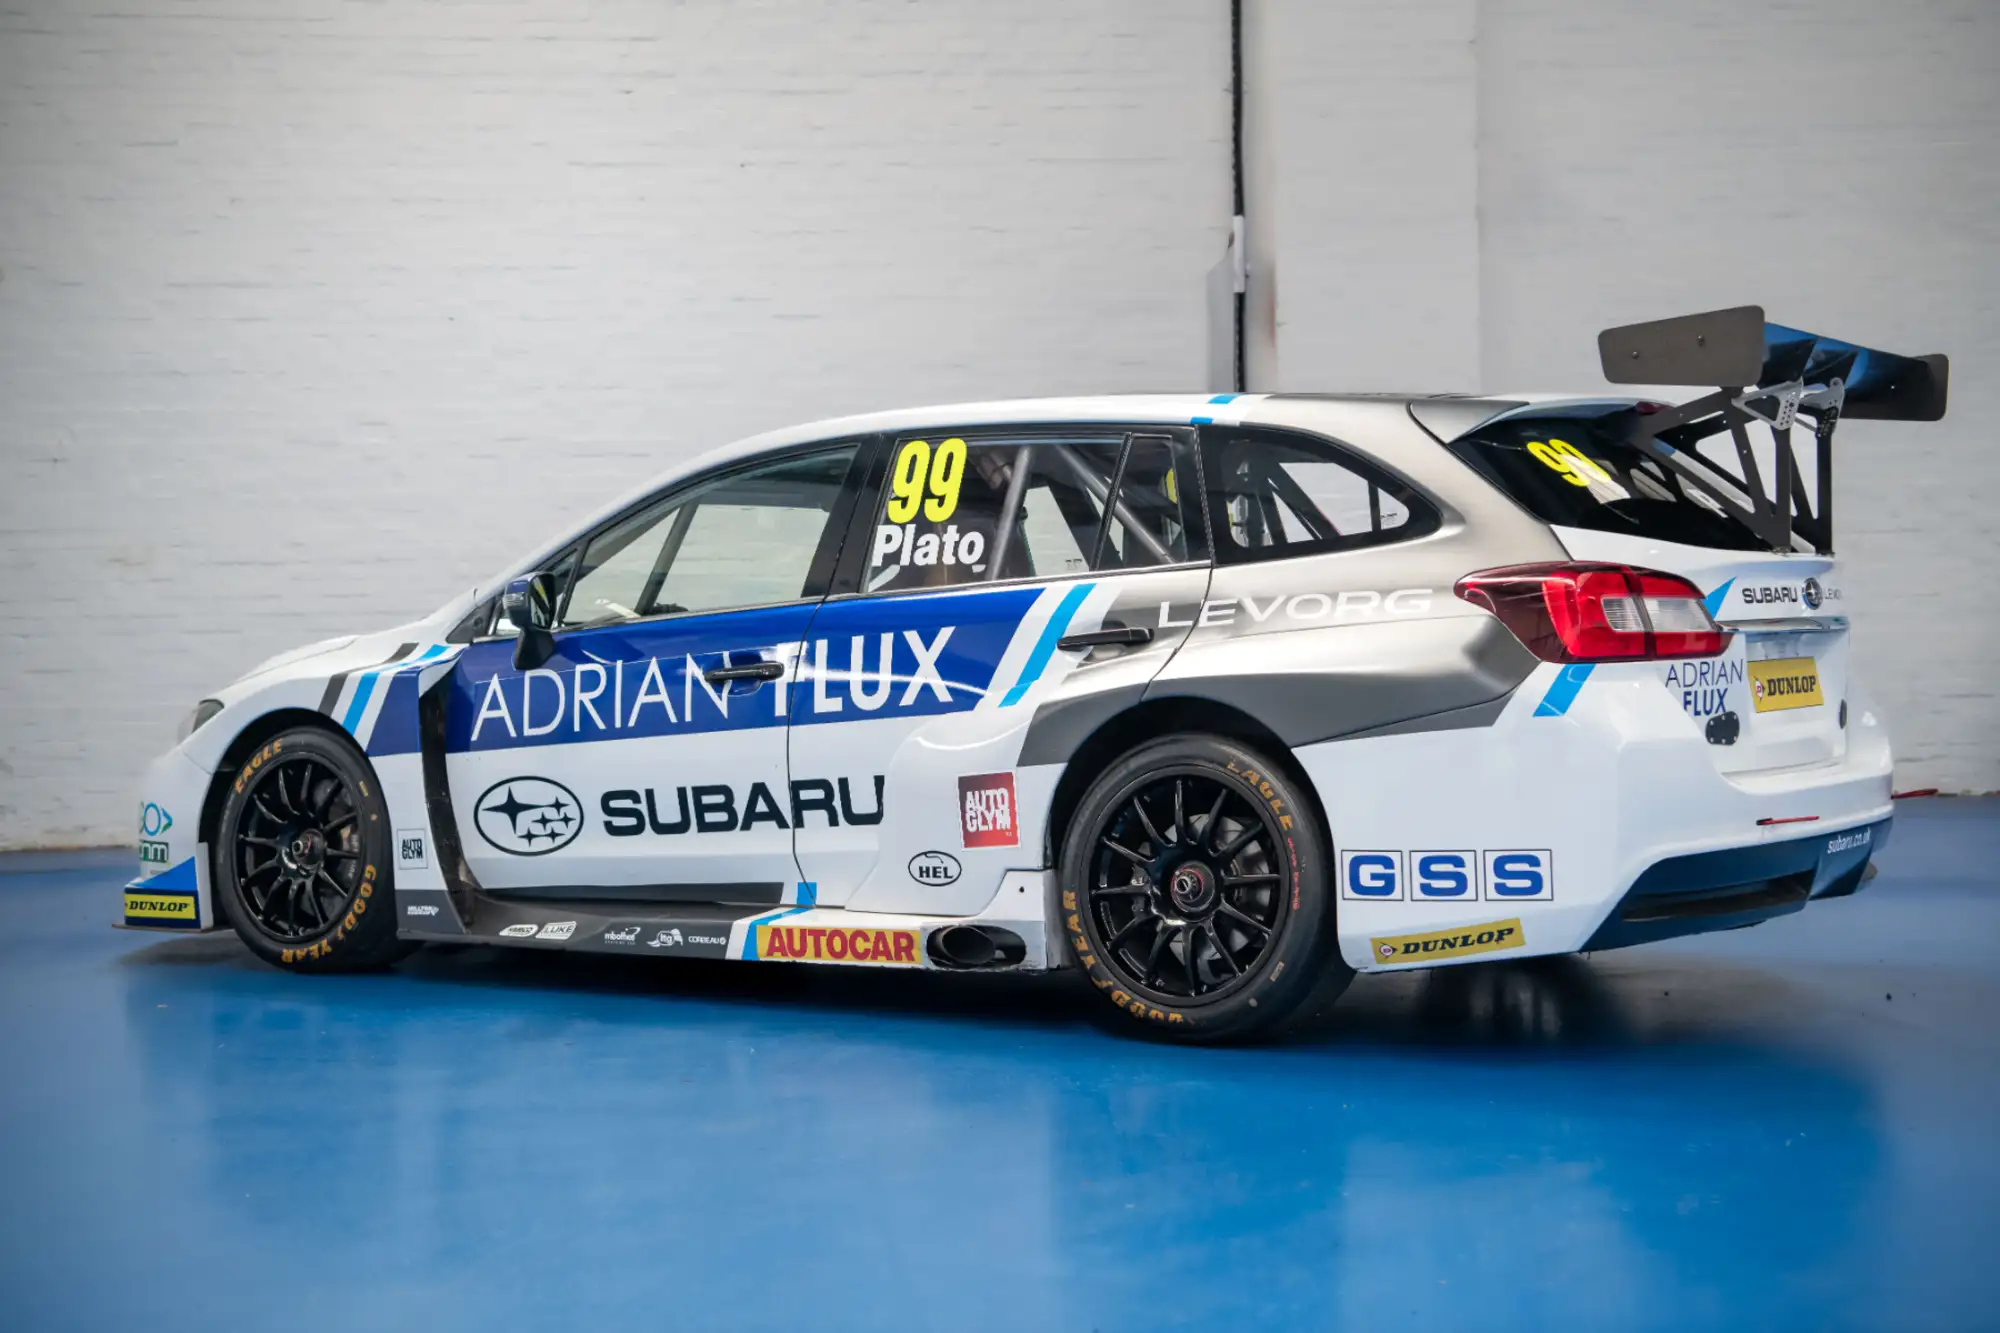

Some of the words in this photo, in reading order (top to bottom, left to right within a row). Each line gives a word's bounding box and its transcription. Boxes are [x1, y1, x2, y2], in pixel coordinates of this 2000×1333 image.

[887, 438, 967, 524] 99
[872, 524, 985, 567] Plato
[1158, 589, 1433, 628] LEVORG
[1742, 587, 1798, 604] SUBARU
[471, 651, 729, 742] ADRIAN
[774, 626, 956, 717] FLUX
[1665, 659, 1743, 688] ADRIAN
[1767, 675, 1816, 696] DUNLOP
[1683, 688, 1728, 716] FLUX
[235, 738, 281, 793] EAGLE
[602, 774, 884, 837] SUBARU
[966, 788, 1009, 812] AUTO
[966, 809, 1011, 832] GLYM
[1827, 827, 1871, 854] subaru.co.uk
[918, 865, 953, 879] HEL
[129, 900, 188, 912] DUNLOP
[766, 927, 915, 962] AUTOCAR
[1400, 927, 1514, 955] DUNLOP
